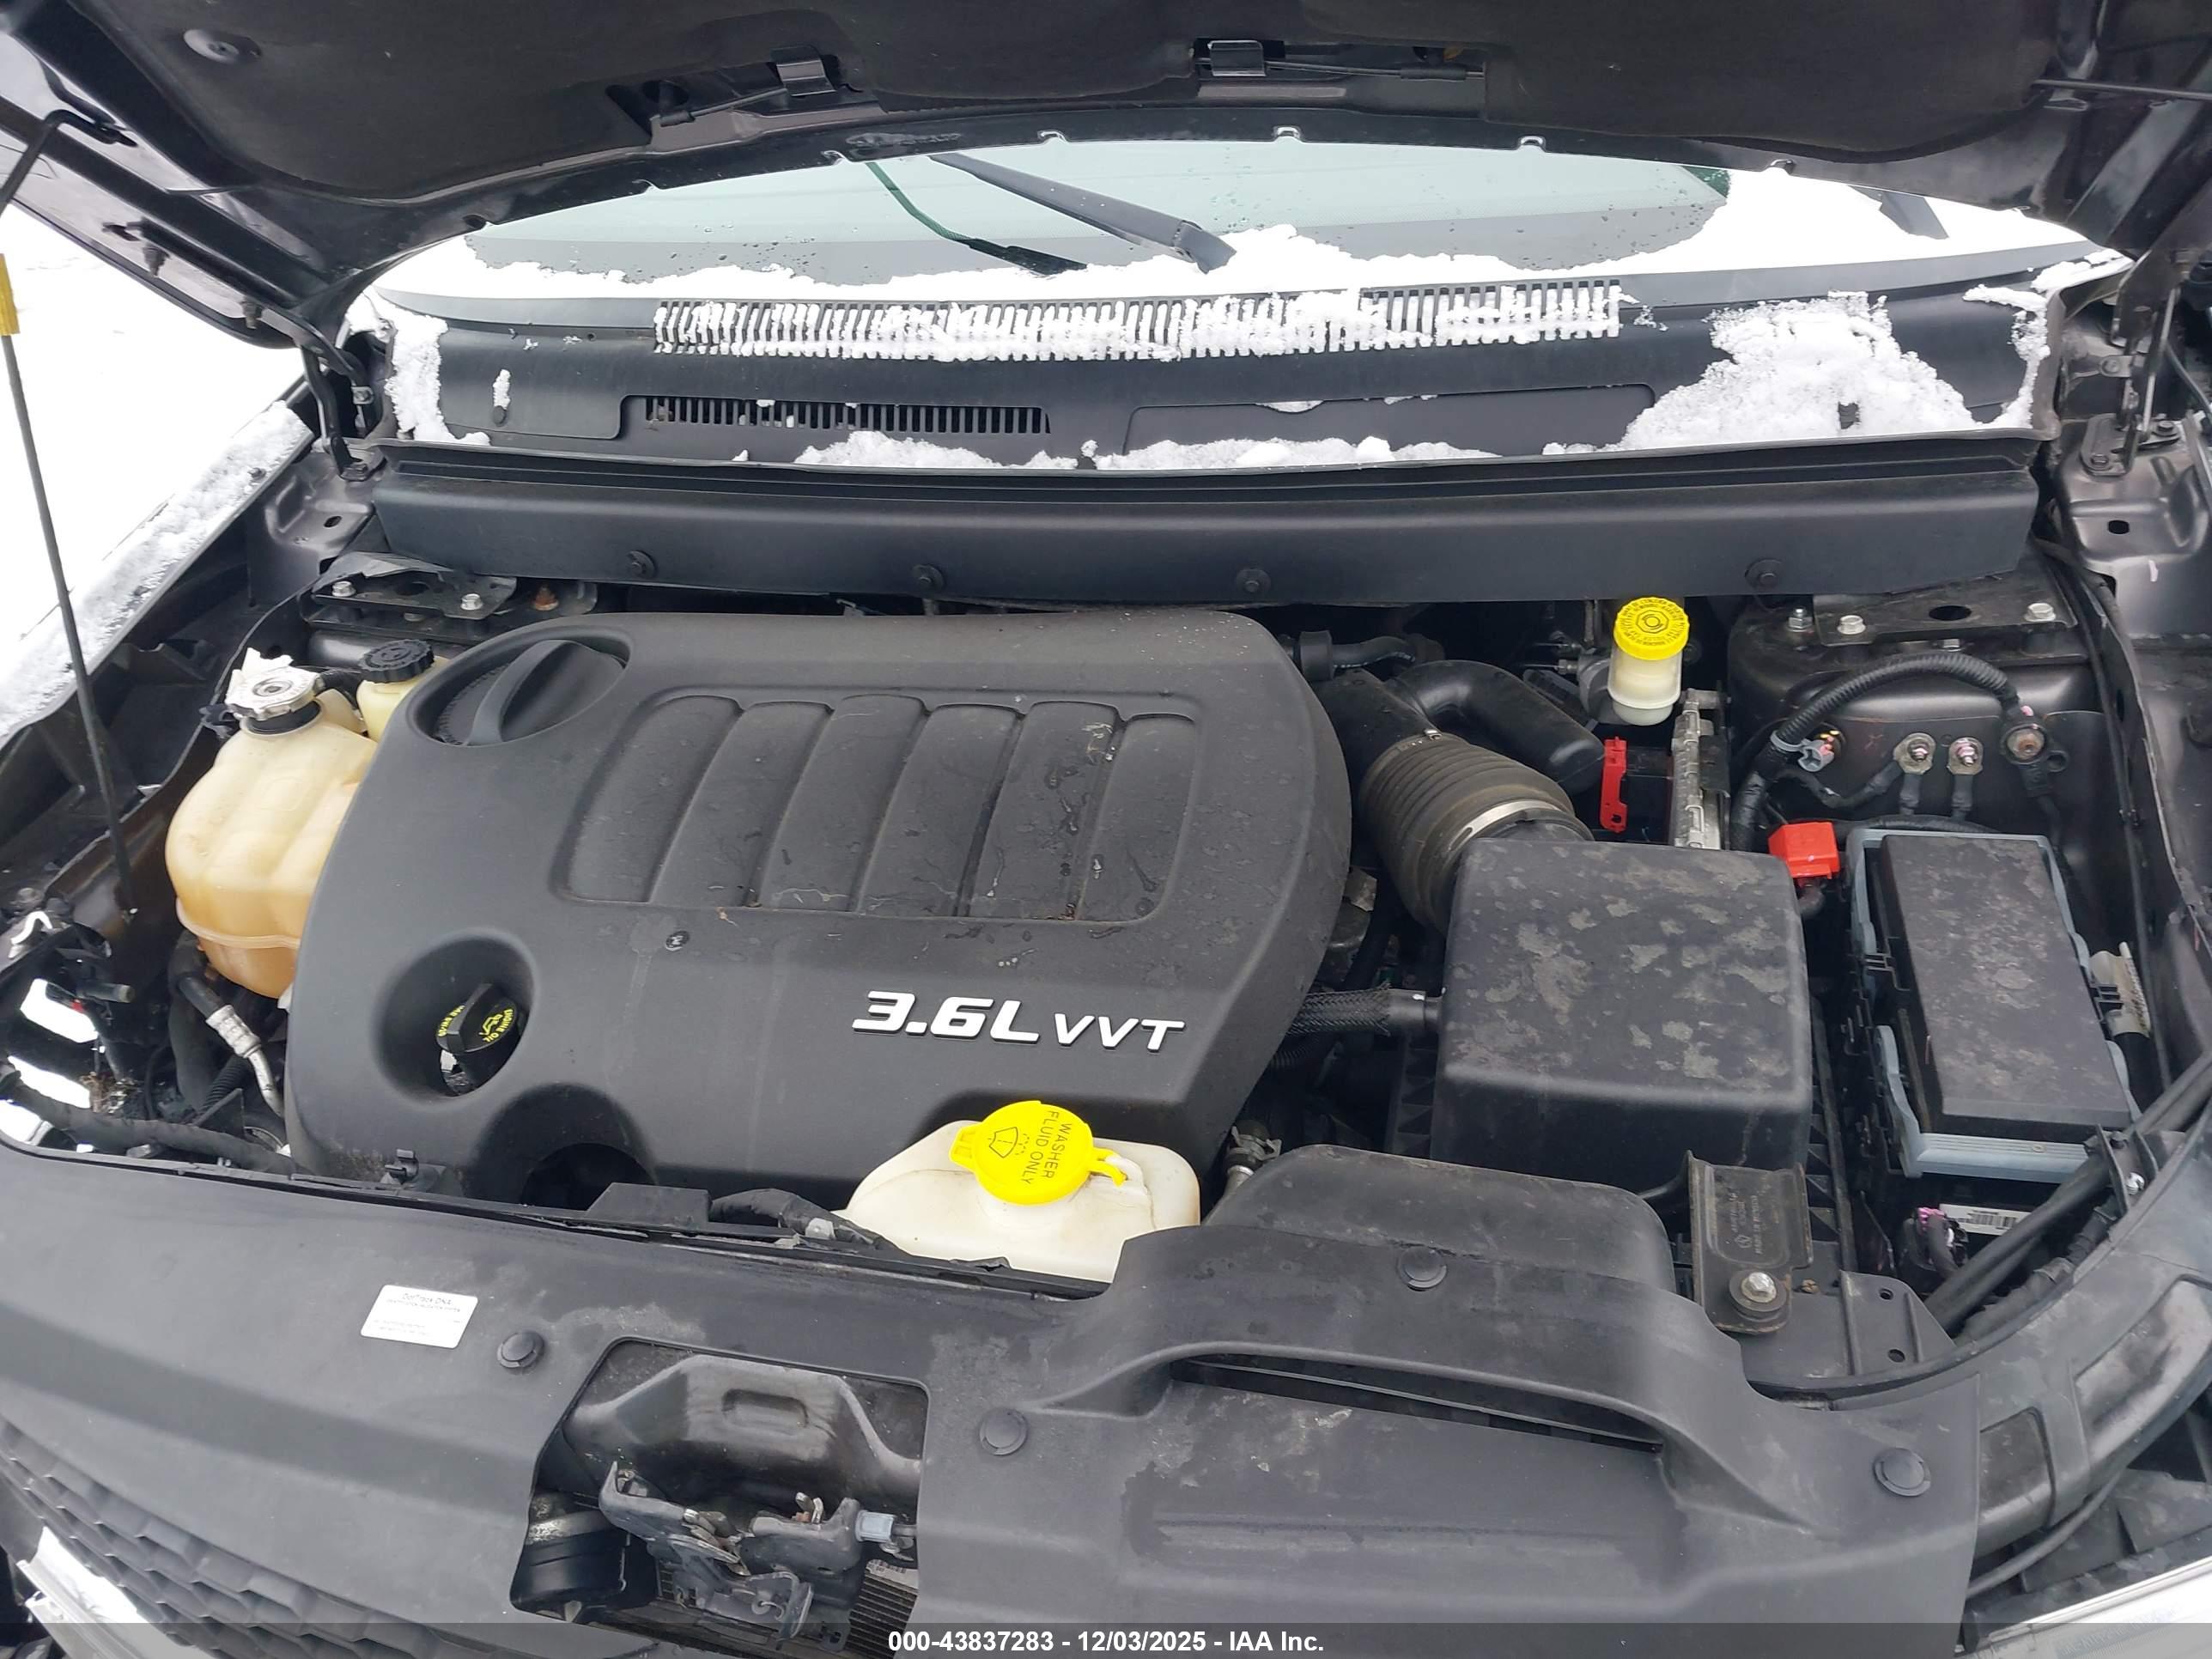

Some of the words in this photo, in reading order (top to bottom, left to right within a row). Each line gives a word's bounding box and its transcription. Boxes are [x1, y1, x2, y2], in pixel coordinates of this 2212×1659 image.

[482, 1032, 500, 1042] OIL
[495, 1009, 514, 1032] ENGINE
[852, 990, 1041, 1045] 3.6L
[1054, 1013, 1186, 1053] VVT
[1035, 1110, 1060, 1147] FLUID
[1021, 1151, 1044, 1184] ONLY
[1042, 1123, 1073, 1179] WASHER
